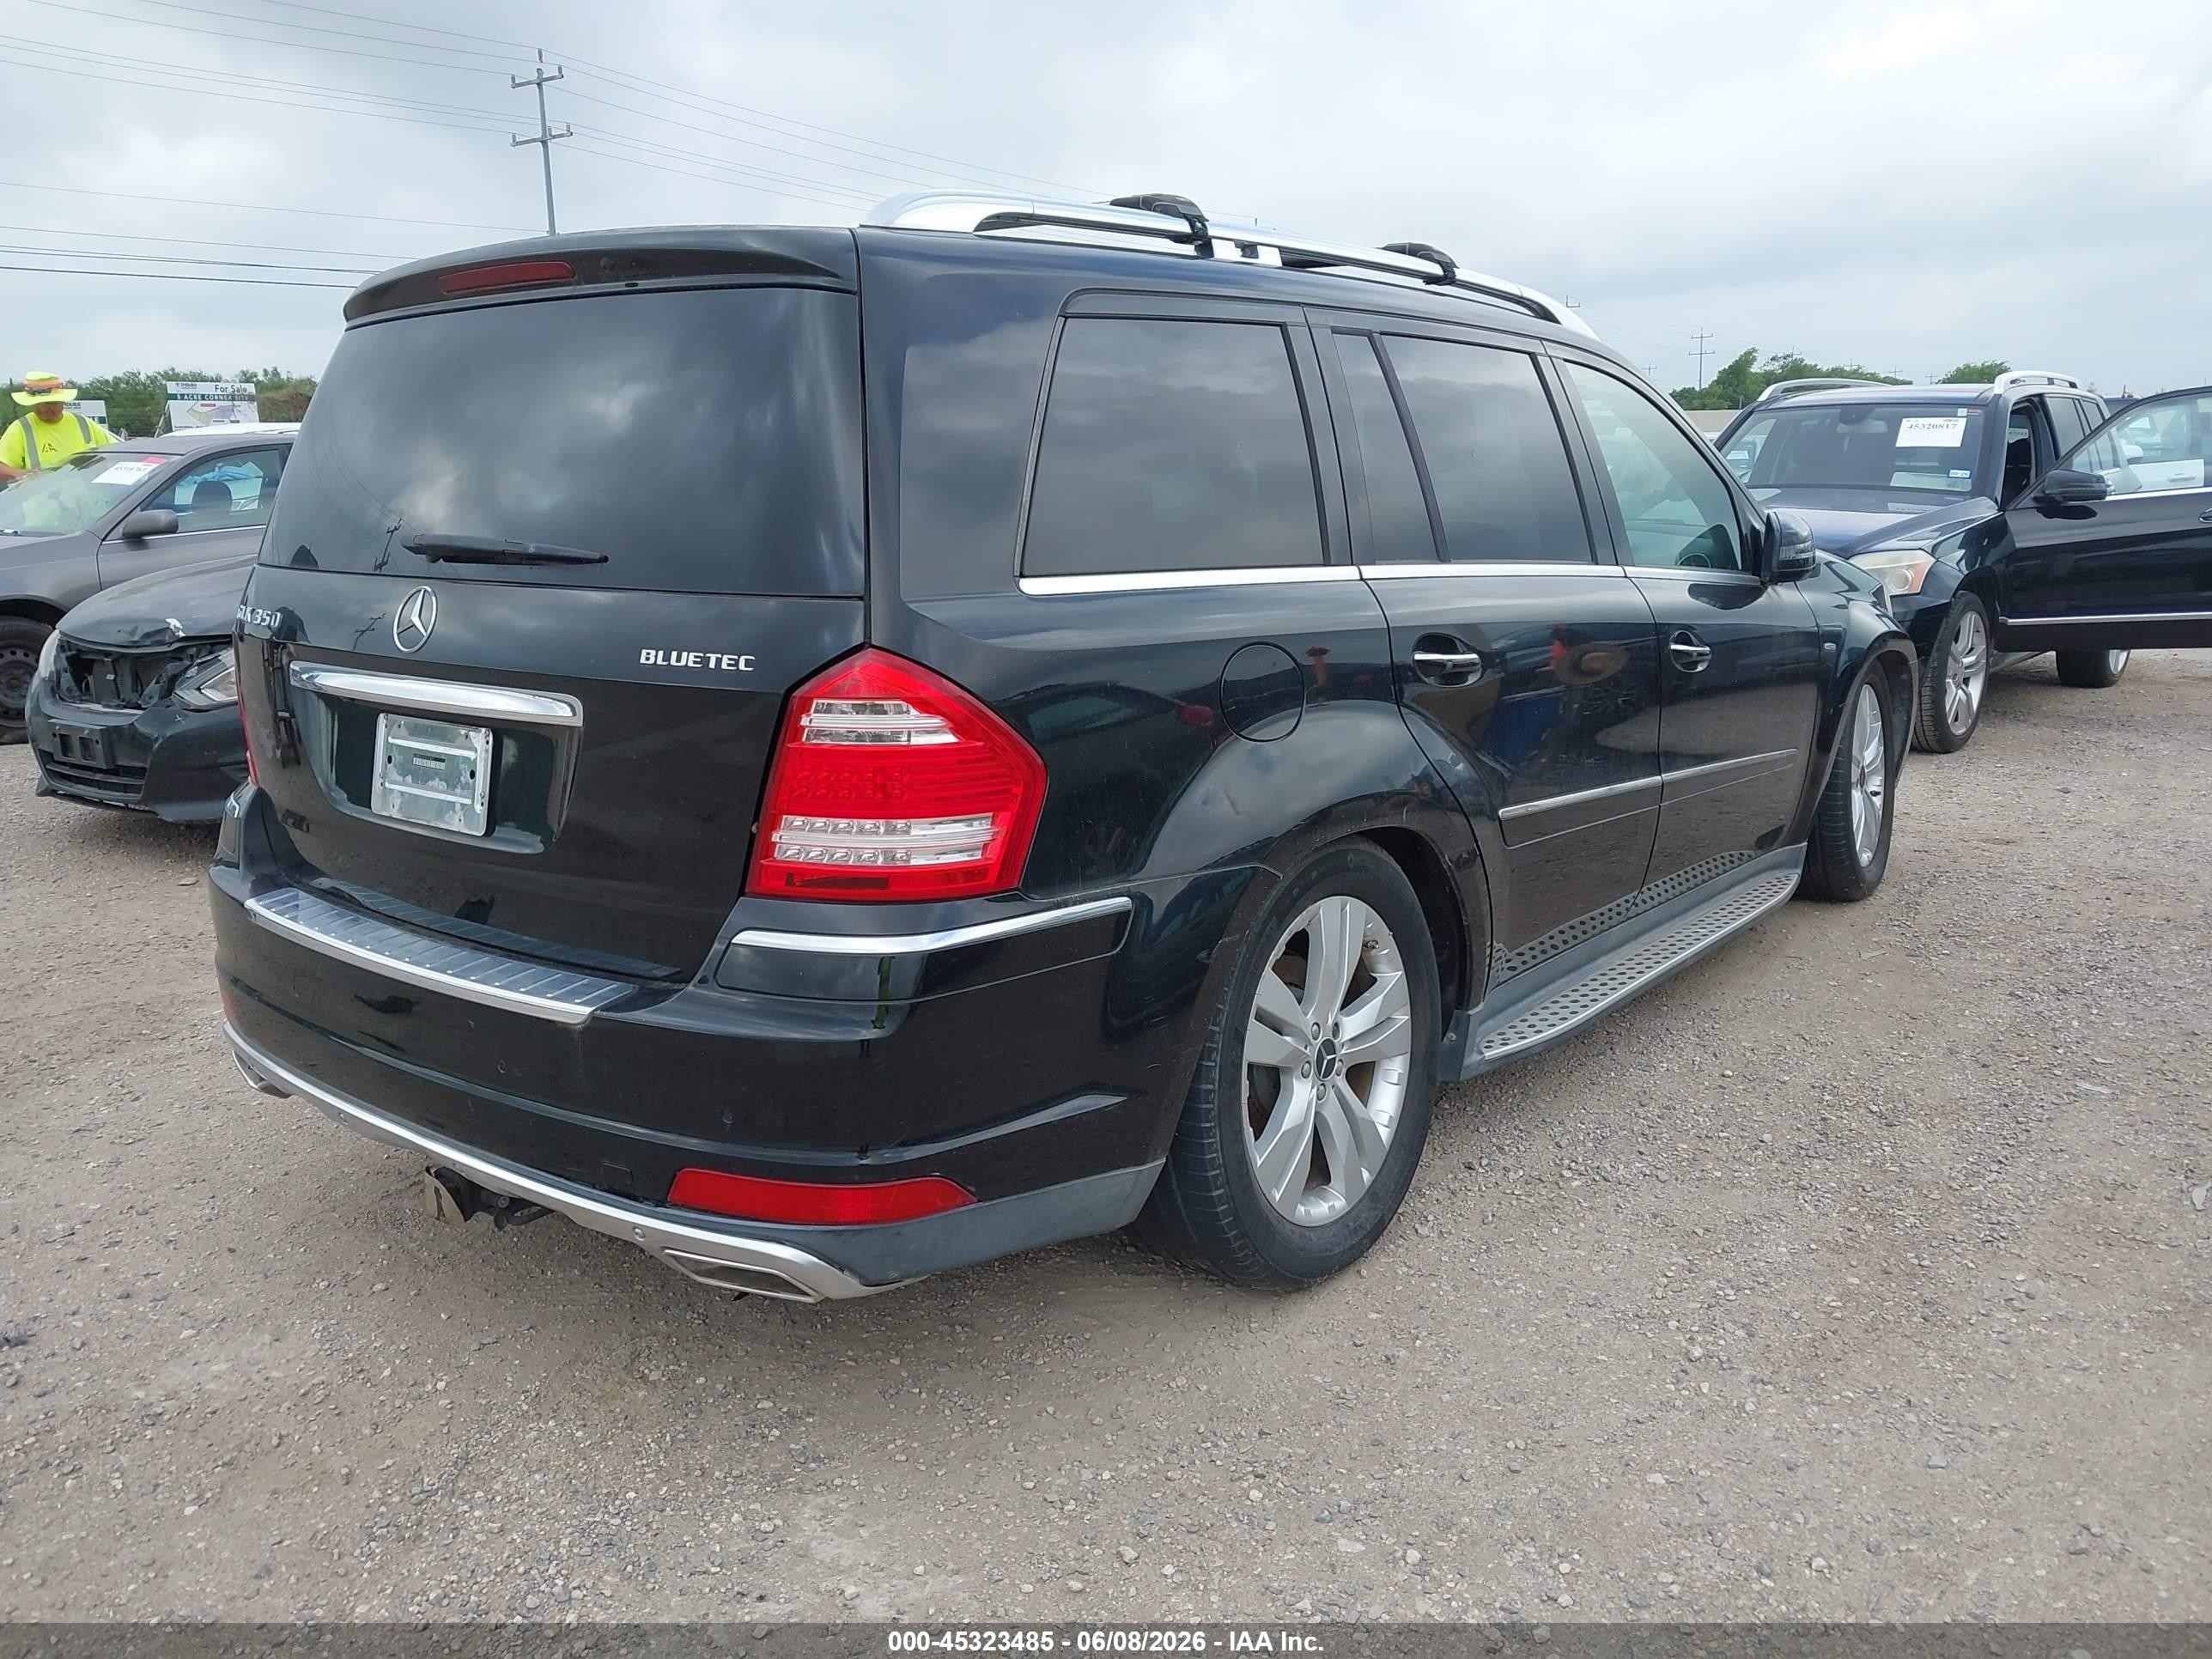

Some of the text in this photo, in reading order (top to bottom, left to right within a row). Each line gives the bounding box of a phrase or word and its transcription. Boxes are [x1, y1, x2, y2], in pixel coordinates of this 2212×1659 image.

[214, 384, 247, 393] For Sale
[640, 649, 756, 671] BLUETEC
